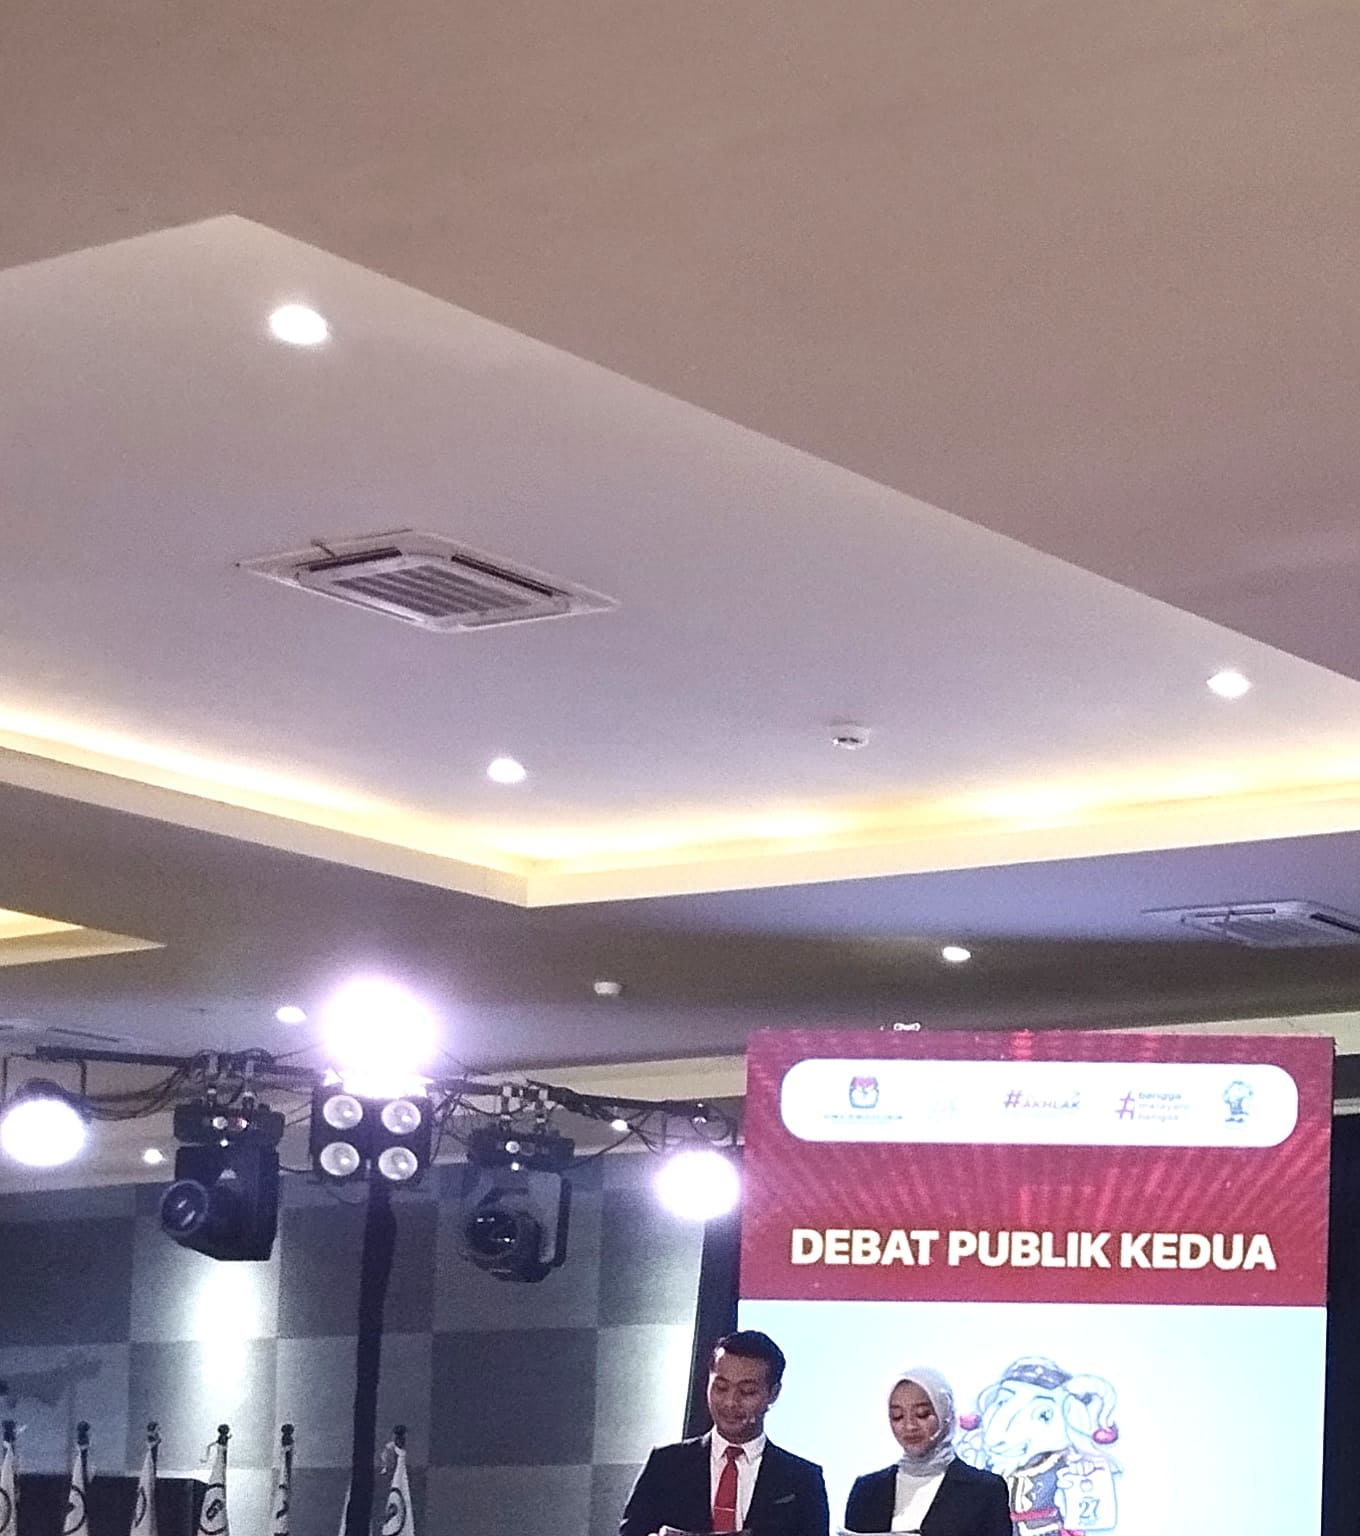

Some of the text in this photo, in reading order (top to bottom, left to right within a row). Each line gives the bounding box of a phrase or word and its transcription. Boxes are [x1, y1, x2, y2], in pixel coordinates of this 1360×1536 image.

[791, 1227, 1277, 1271] DEBAT PUBLIK KEDUA
